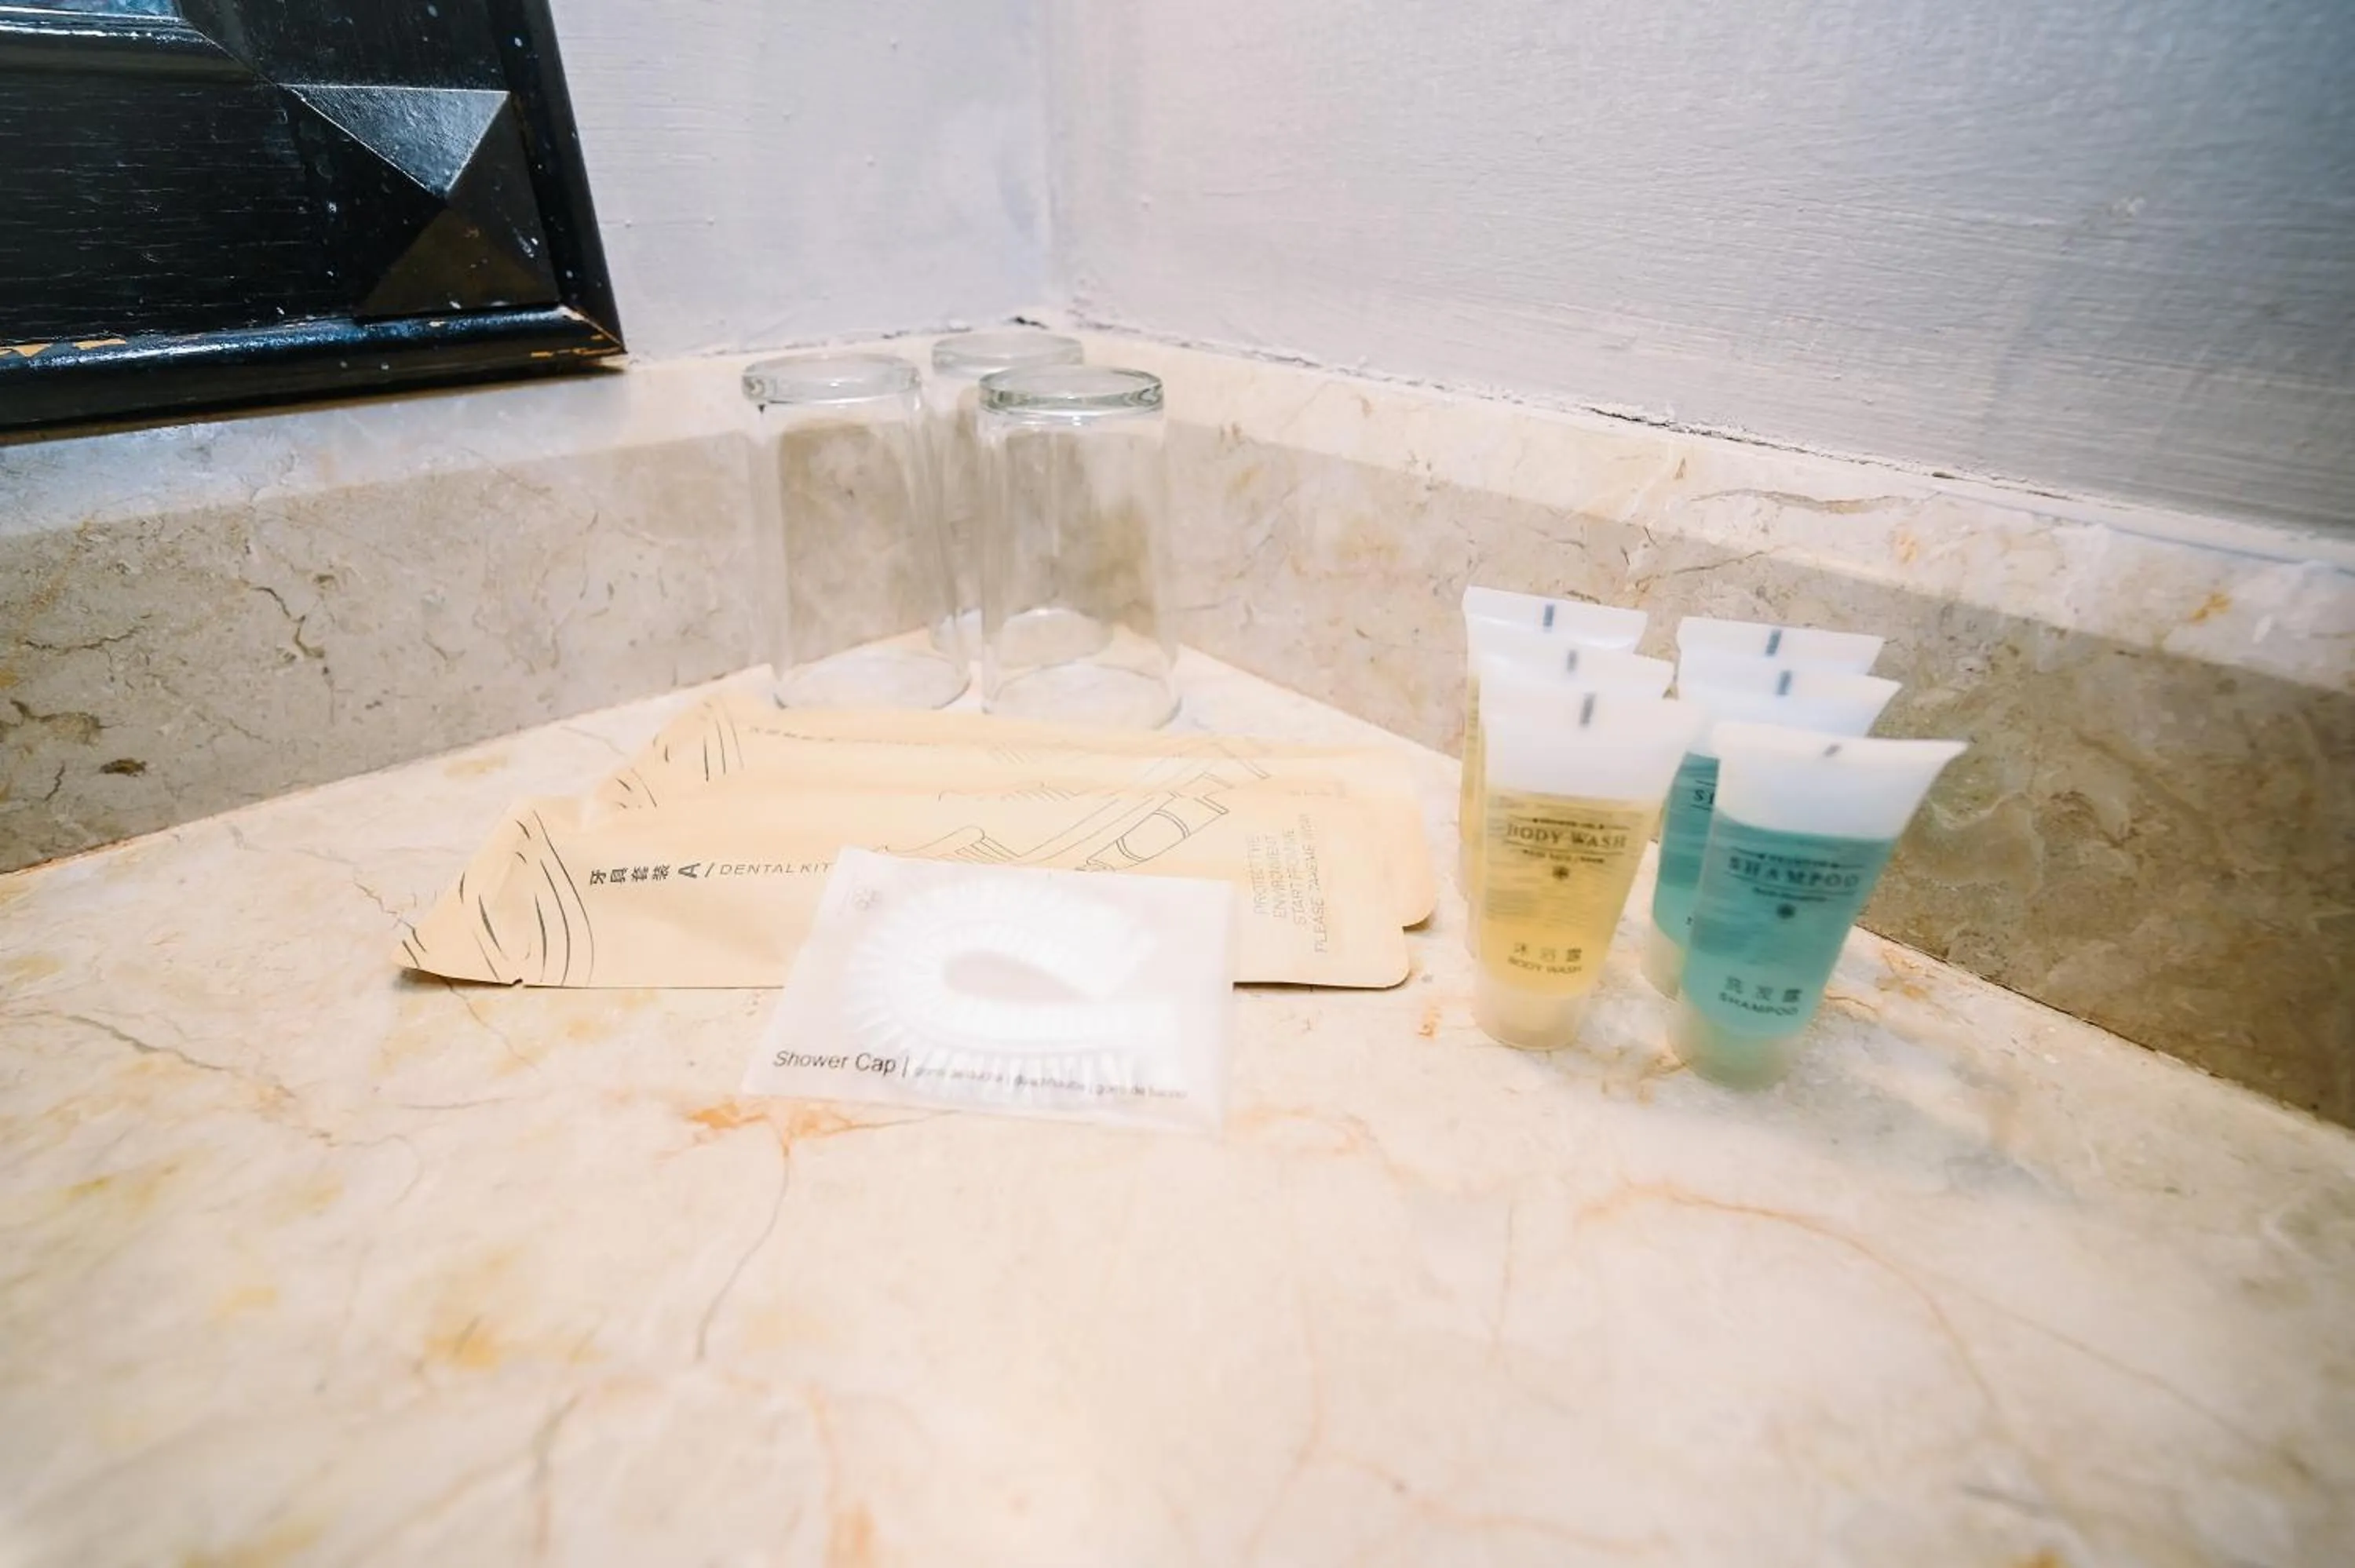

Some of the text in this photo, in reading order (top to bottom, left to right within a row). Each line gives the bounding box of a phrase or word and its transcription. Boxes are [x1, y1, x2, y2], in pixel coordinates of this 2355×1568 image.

[1506, 822, 1561, 844] BODY
[1571, 830, 1627, 848] WASH
[719, 862, 794, 876] DENTAL
[800, 862, 835, 873] KIT
[1729, 855, 1860, 888] SHAMPOO
[1718, 990, 1799, 1017] SHAMPOO
[772, 1050, 849, 1069] Shower
[855, 1052, 896, 1077] Cap
